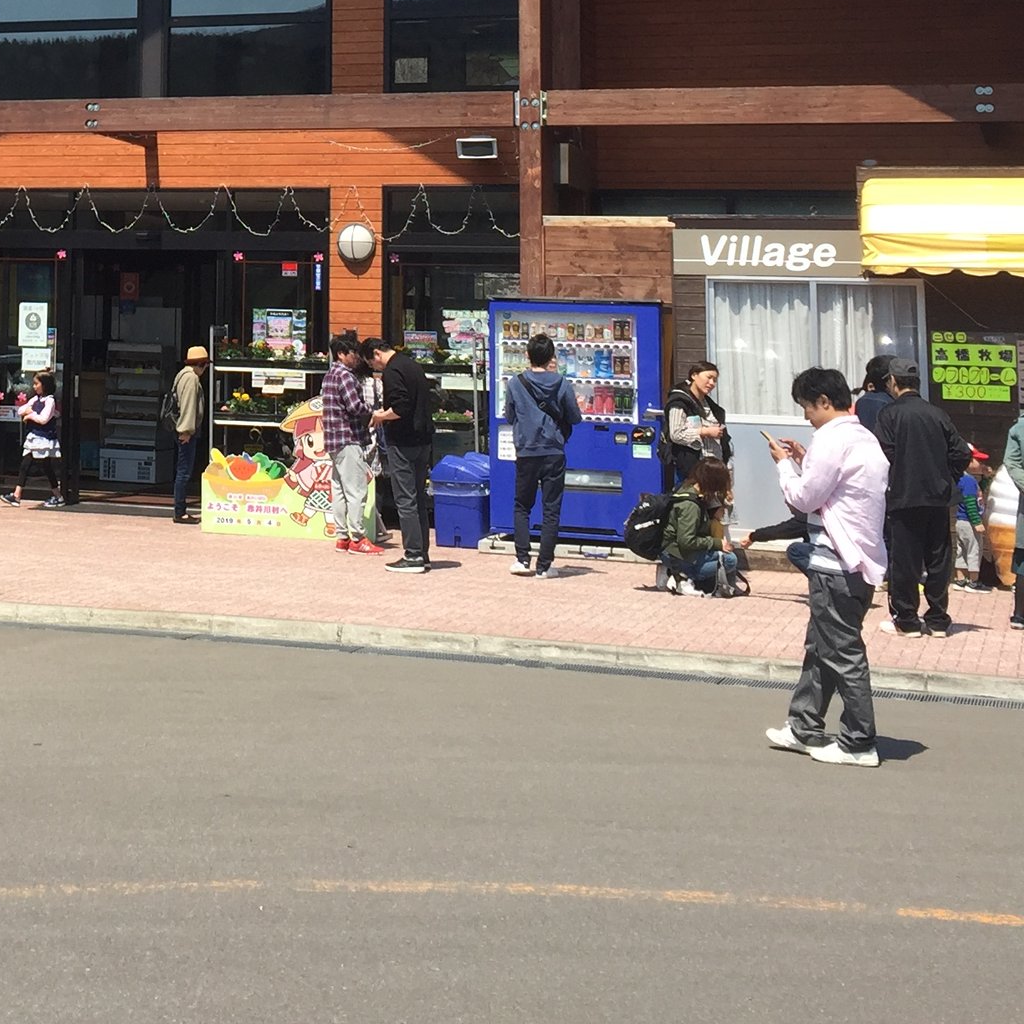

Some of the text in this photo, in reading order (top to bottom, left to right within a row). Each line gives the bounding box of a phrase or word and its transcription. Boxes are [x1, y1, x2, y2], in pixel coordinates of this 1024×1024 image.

[700, 234, 837, 272] Village
[935, 348, 1013, 363] 高橋牧場
[934, 368, 1015, 384] ソフトクリーム
[207, 502, 238, 512] ようこそ
